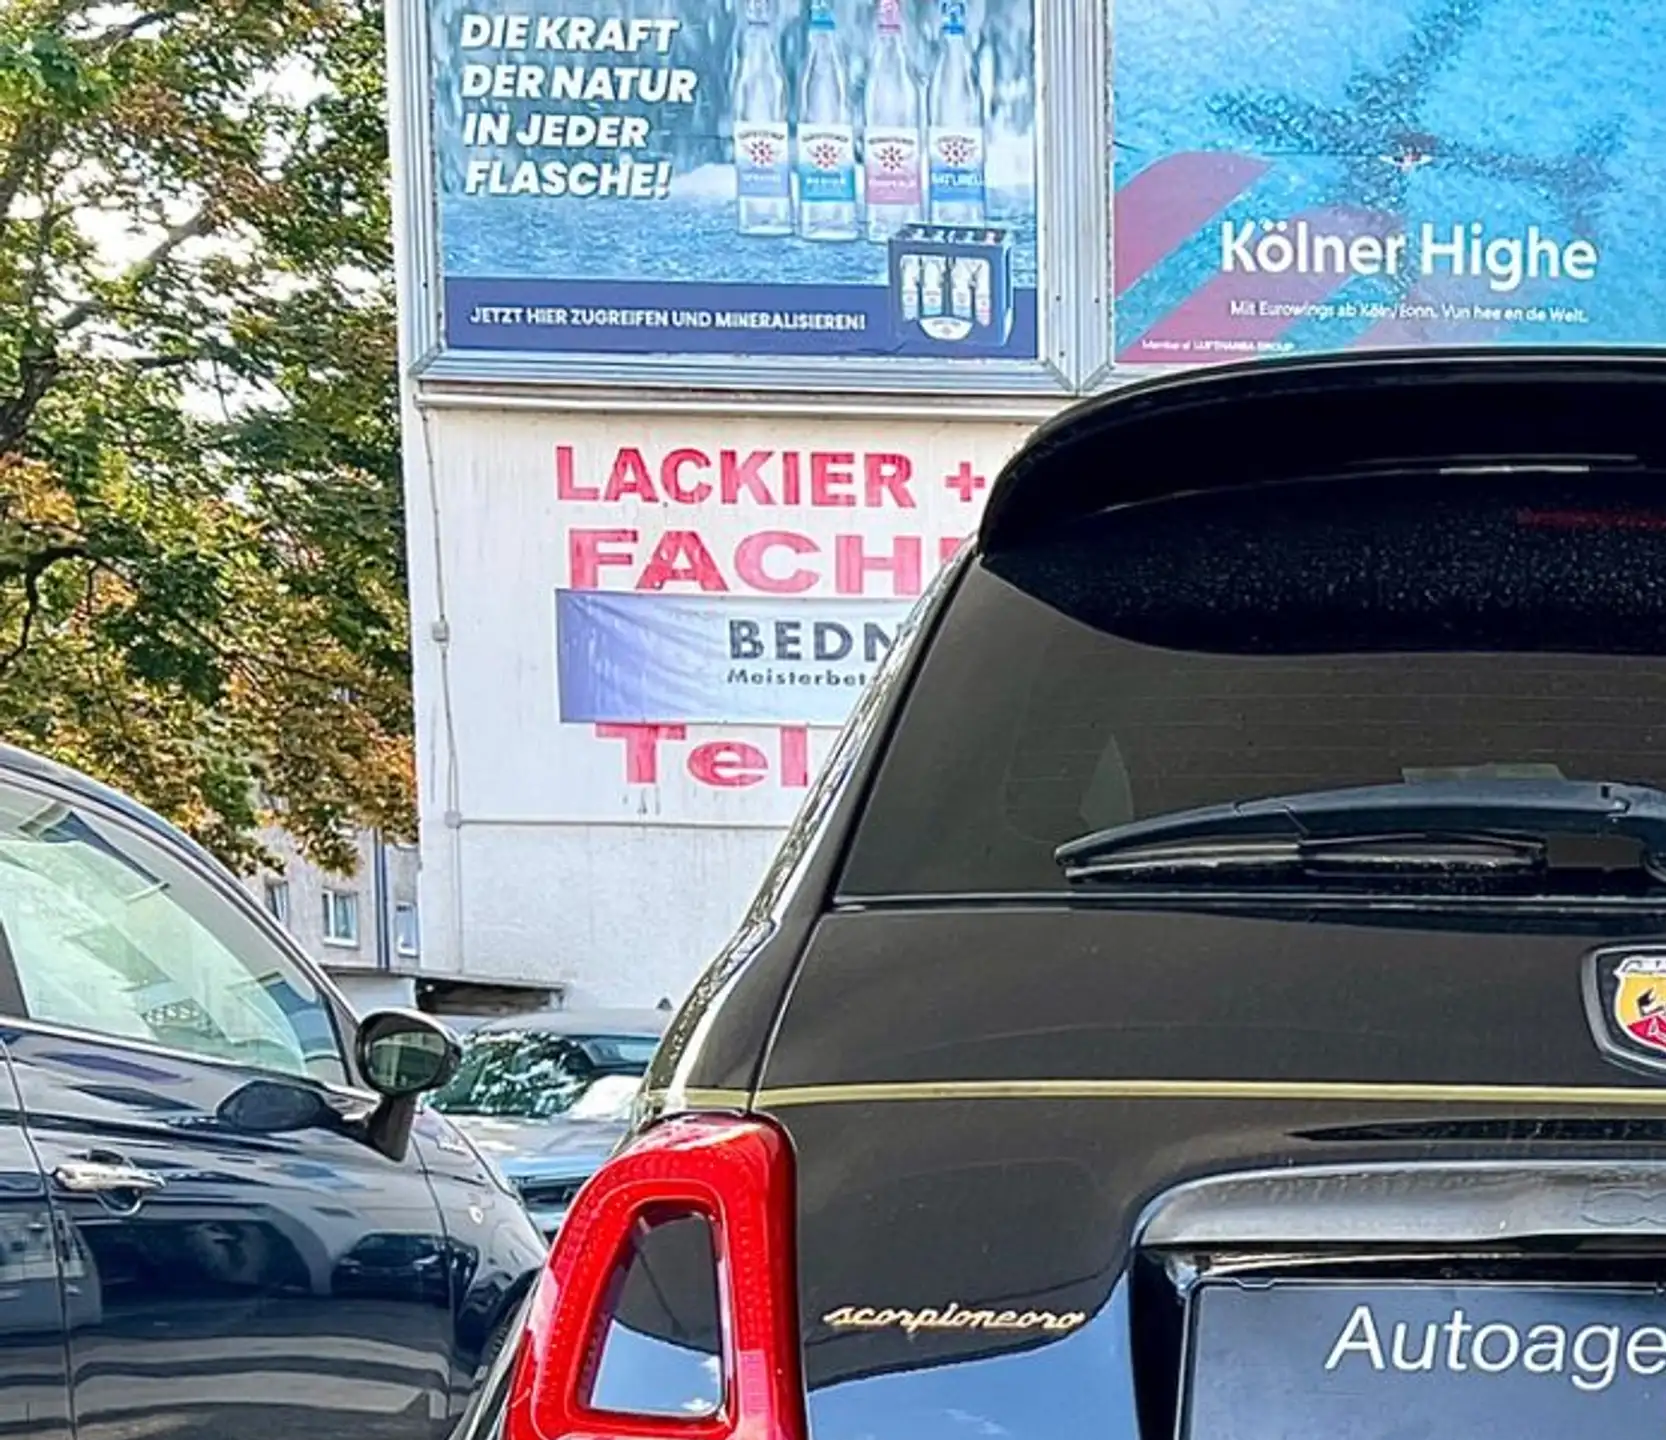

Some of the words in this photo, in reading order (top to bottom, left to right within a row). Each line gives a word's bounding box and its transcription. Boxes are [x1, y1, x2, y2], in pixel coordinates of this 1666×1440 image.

[461, 15, 528, 49] DIE
[536, 17, 680, 54] KRAFT
[461, 64, 546, 101] DER
[551, 67, 697, 104] NATUR
[463, 113, 511, 147] IN
[516, 114, 650, 149] JEDER
[463, 159, 672, 199] FLASCHE!
[1220, 217, 1406, 276] Kölner
[1420, 220, 1598, 291] Highe
[470, 306, 522, 326] JETZT
[527, 307, 566, 326] HIER
[570, 308, 668, 328] ZUGREIFEN
[672, 310, 711, 328] UND
[715, 311, 866, 331] MINERALISIEREN!
[1230, 301, 1256, 317] Mit
[1259, 302, 1335, 321] Eurowings
[1337, 303, 1357, 318] ab
[1442, 304, 1470, 320] Vun
[1472, 305, 1501, 321] hee
[1503, 310, 1523, 322] en
[1525, 307, 1546, 322] de
[1548, 306, 1589, 323] Welt.
[556, 446, 917, 509] LACKIER
[944, 461, 986, 503] +
[726, 667, 868, 687] Meisterbet
[595, 722, 810, 788] Tel
[823, 1302, 1088, 1336] scorpioneoro
